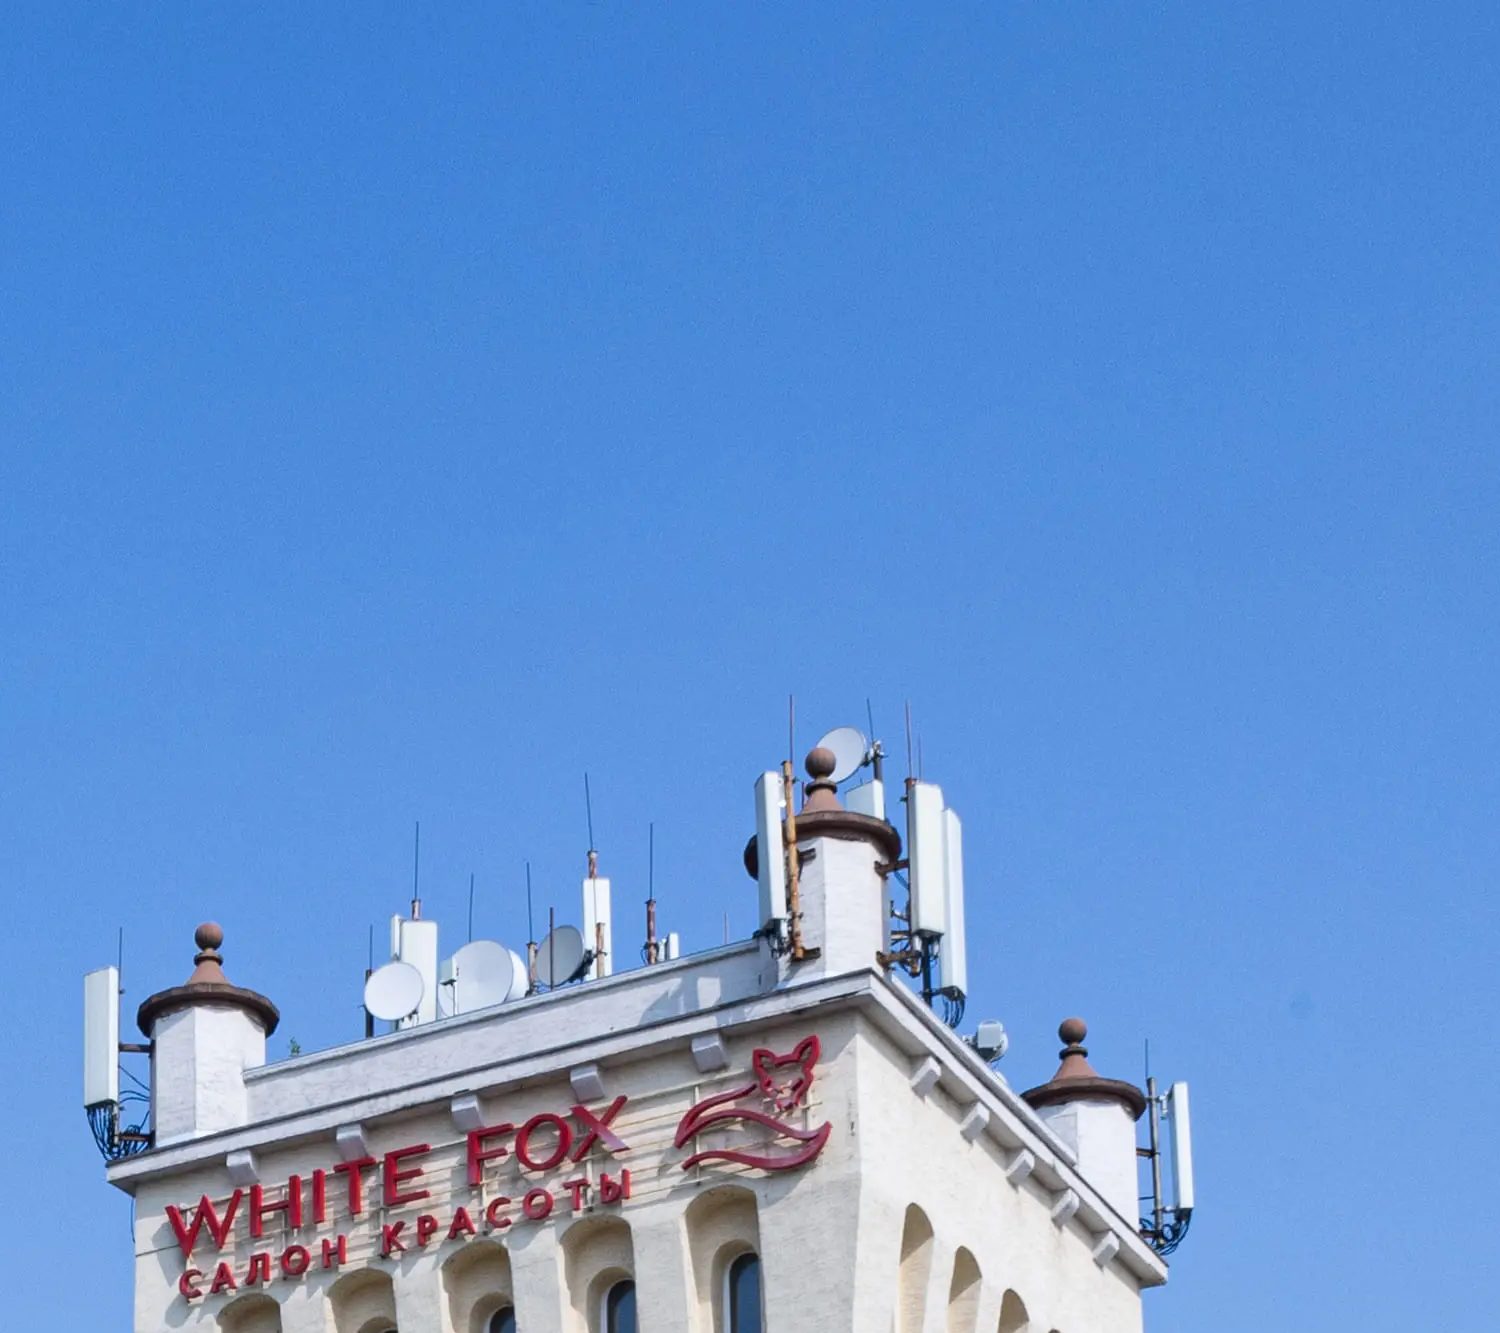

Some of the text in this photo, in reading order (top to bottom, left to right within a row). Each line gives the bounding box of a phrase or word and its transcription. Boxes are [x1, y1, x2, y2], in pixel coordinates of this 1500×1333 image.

[166, 1095, 629, 1257] WHITE FOX
[178, 1169, 631, 1300] САЛОН КРАСОТЫ
